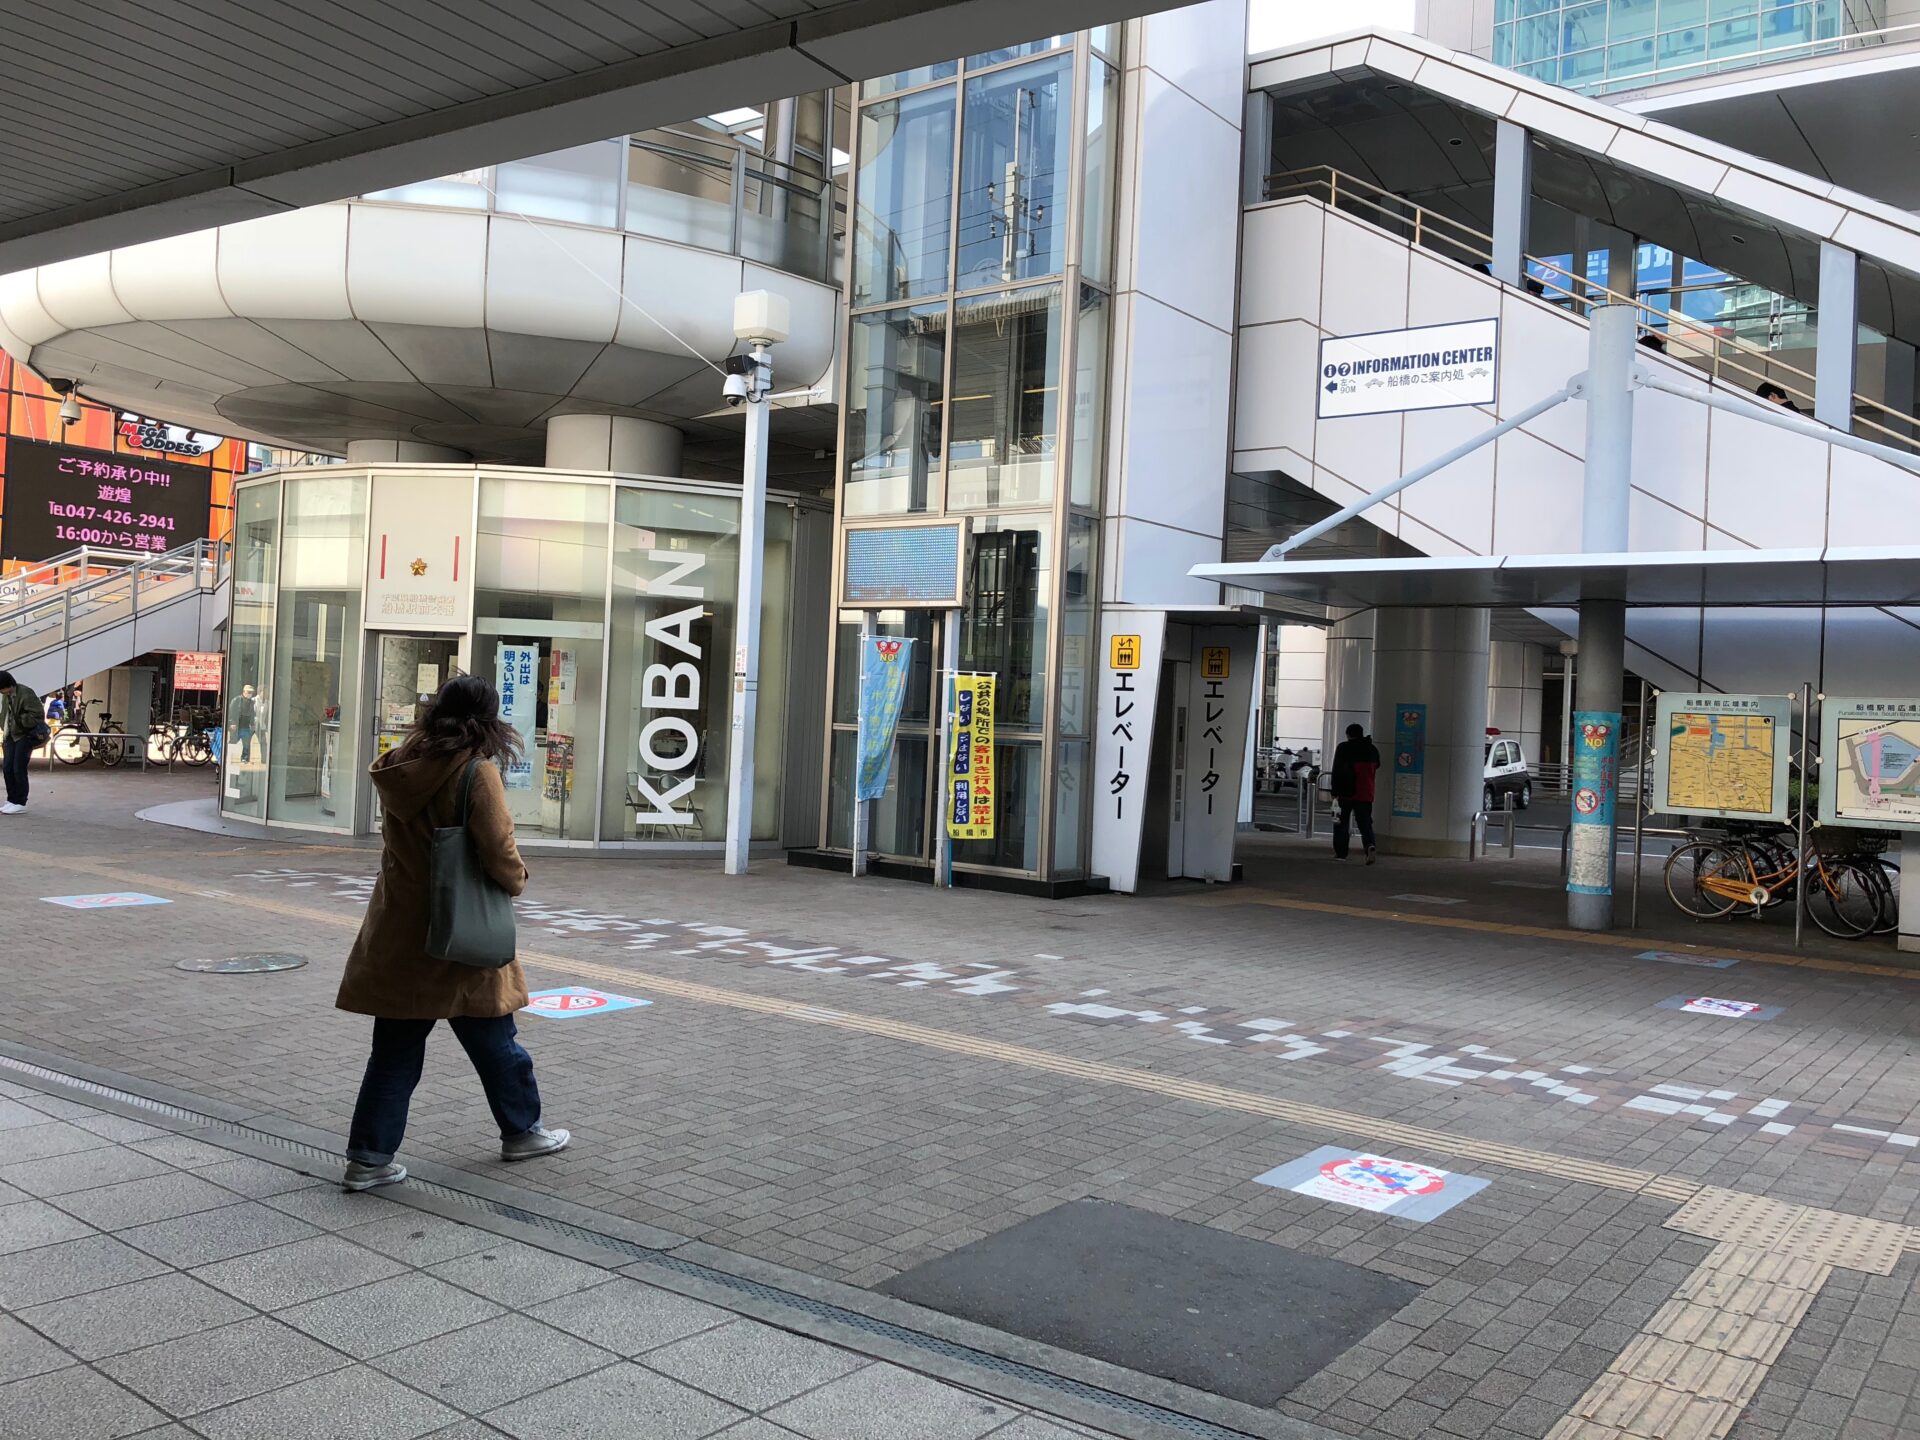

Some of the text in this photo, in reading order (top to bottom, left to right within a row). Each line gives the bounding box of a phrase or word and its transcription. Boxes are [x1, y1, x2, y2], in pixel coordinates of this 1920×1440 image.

[1352, 346, 1493, 376] INFORMATION CENTER
[1340, 378, 1356, 386] 左へ
[1340, 385, 1356, 394] 90M
[1387, 369, 1465, 388] 船橋のご案内処
[119, 421, 169, 441] MEGA
[128, 434, 203, 456] GODDESS
[58, 457, 170, 487] ご予約承り中!!
[97, 484, 132, 503] 遊煌
[56, 525, 167, 550] 16:00から営業
[519, 651, 531, 685] 外出は
[879, 652, 897, 662] NO!
[637, 549, 705, 825] KOBAN
[959, 692, 971, 723] しない
[973, 681, 991, 825] 公共の場所での客引き行為は禁止
[1110, 673, 1135, 820] エレベーター
[1201, 681, 1225, 815] エレベーター
[1584, 737, 1606, 747] NO!
[955, 781, 967, 823] 利用しない
